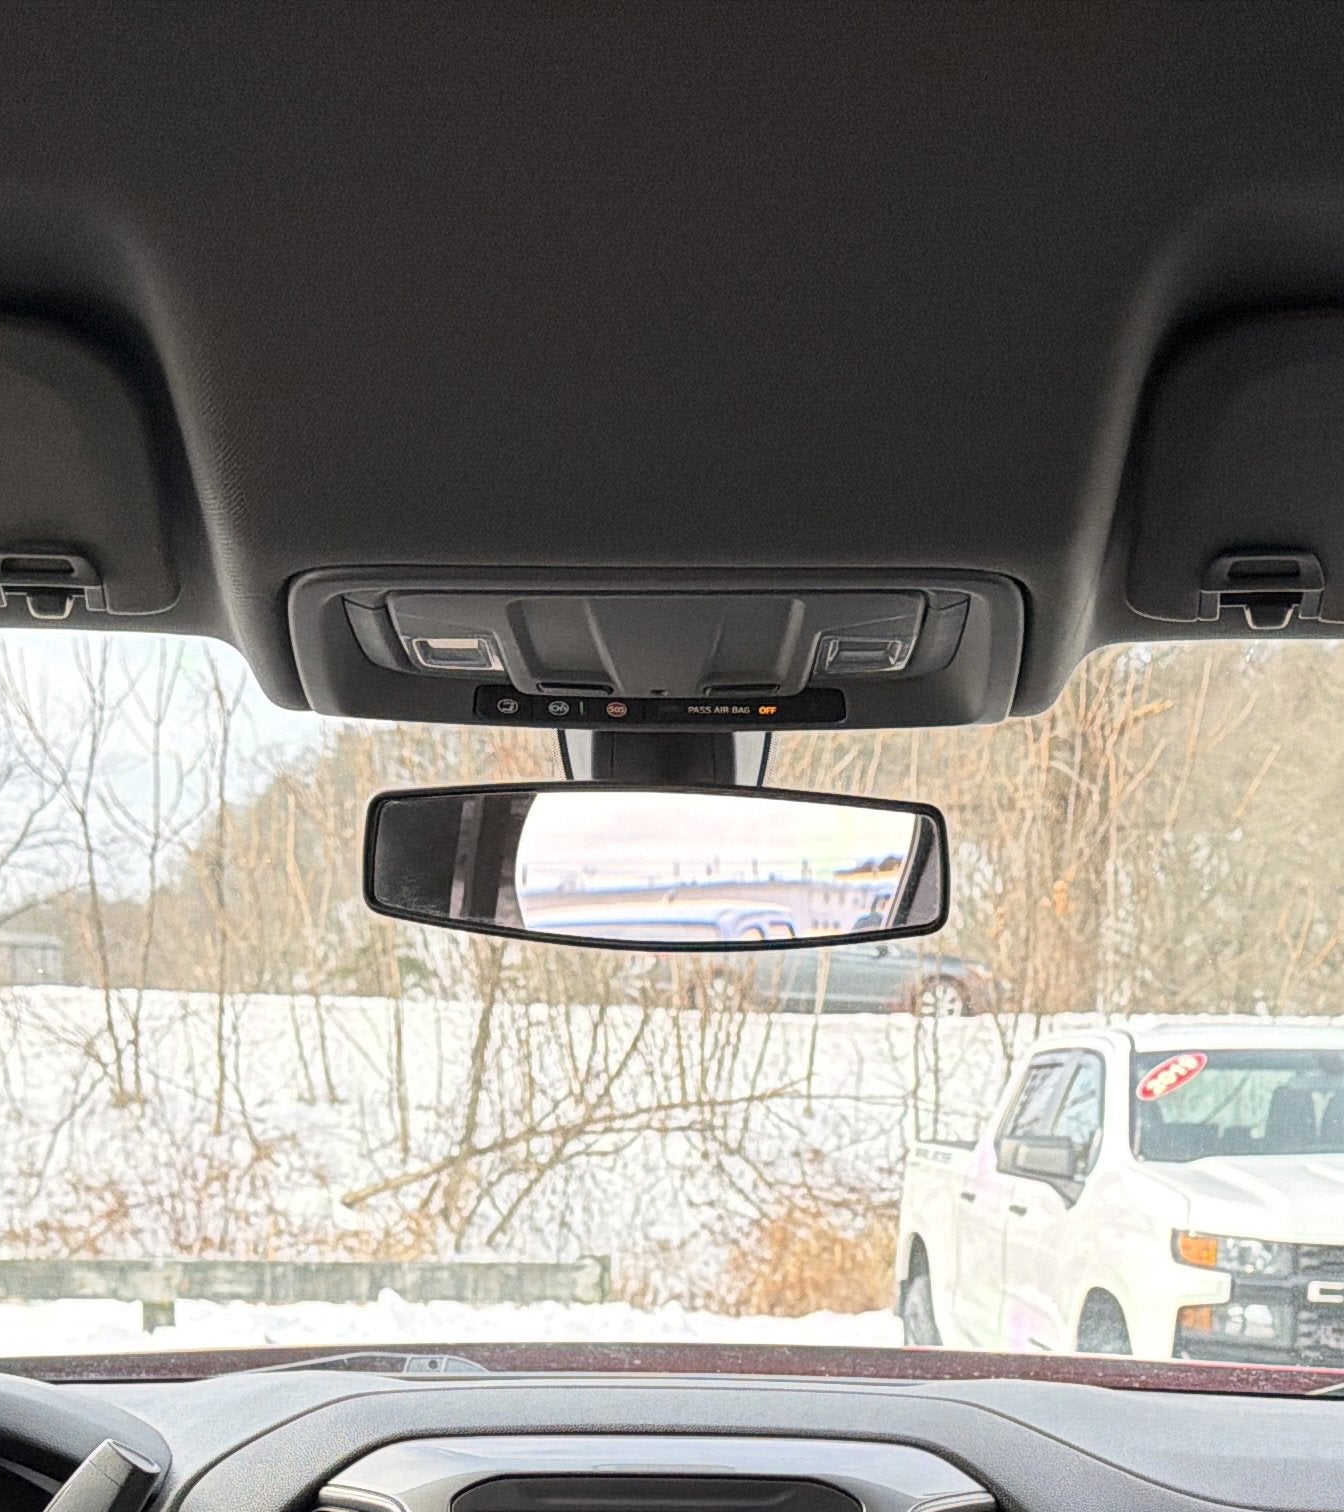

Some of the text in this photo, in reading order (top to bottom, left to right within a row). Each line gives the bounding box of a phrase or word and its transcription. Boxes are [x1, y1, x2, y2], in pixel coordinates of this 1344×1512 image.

[687, 705, 778, 716] PASS AIR BAG OFF
